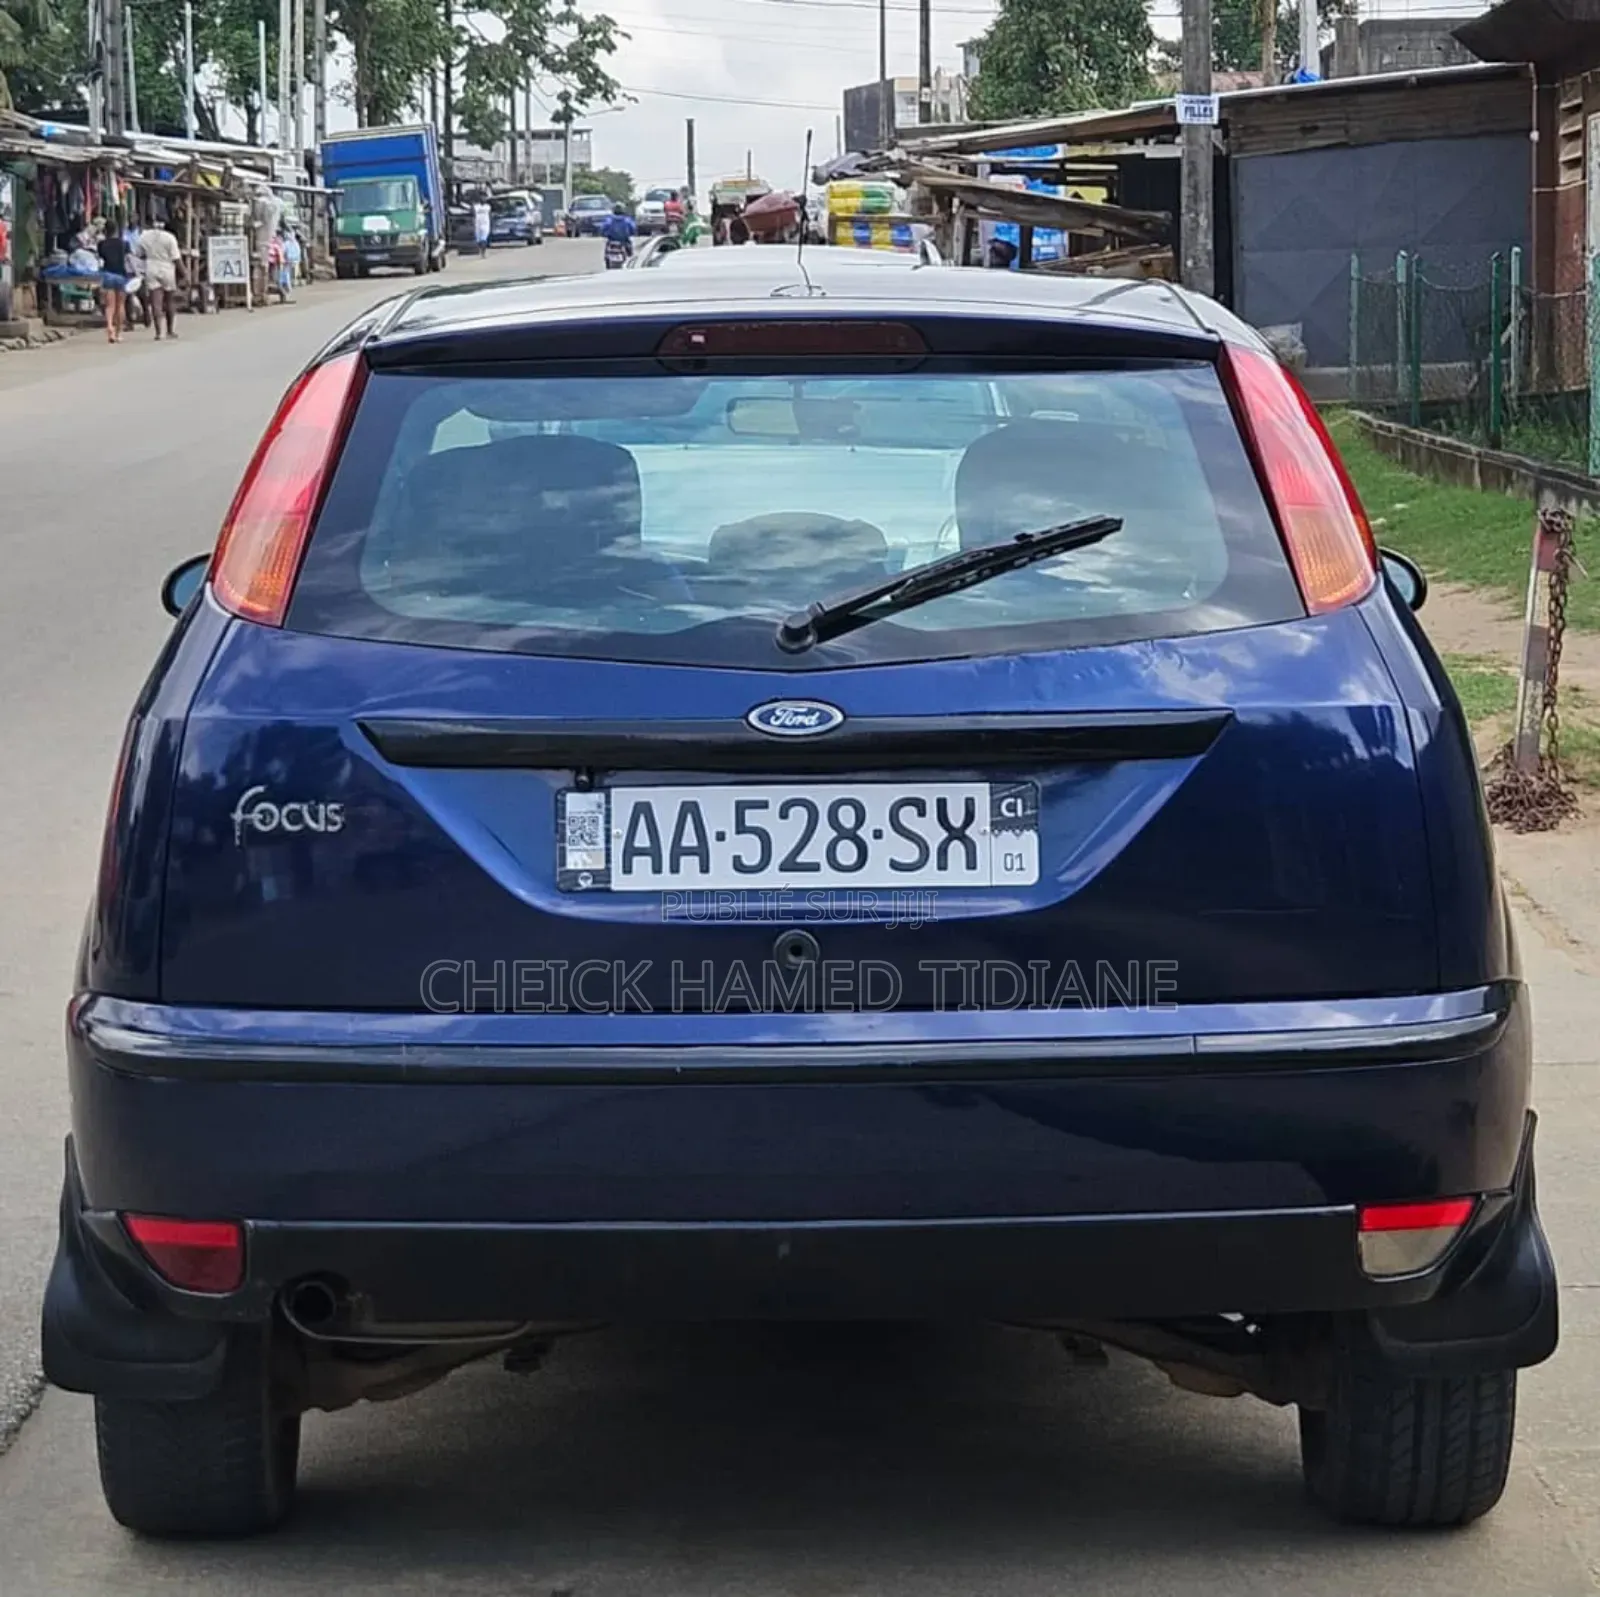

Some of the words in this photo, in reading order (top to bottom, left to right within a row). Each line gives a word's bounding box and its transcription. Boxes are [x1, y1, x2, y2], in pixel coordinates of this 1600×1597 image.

[770, 707, 821, 727] Ford
[1001, 798, 1023, 818] CI
[1004, 853, 1026, 872] 01
